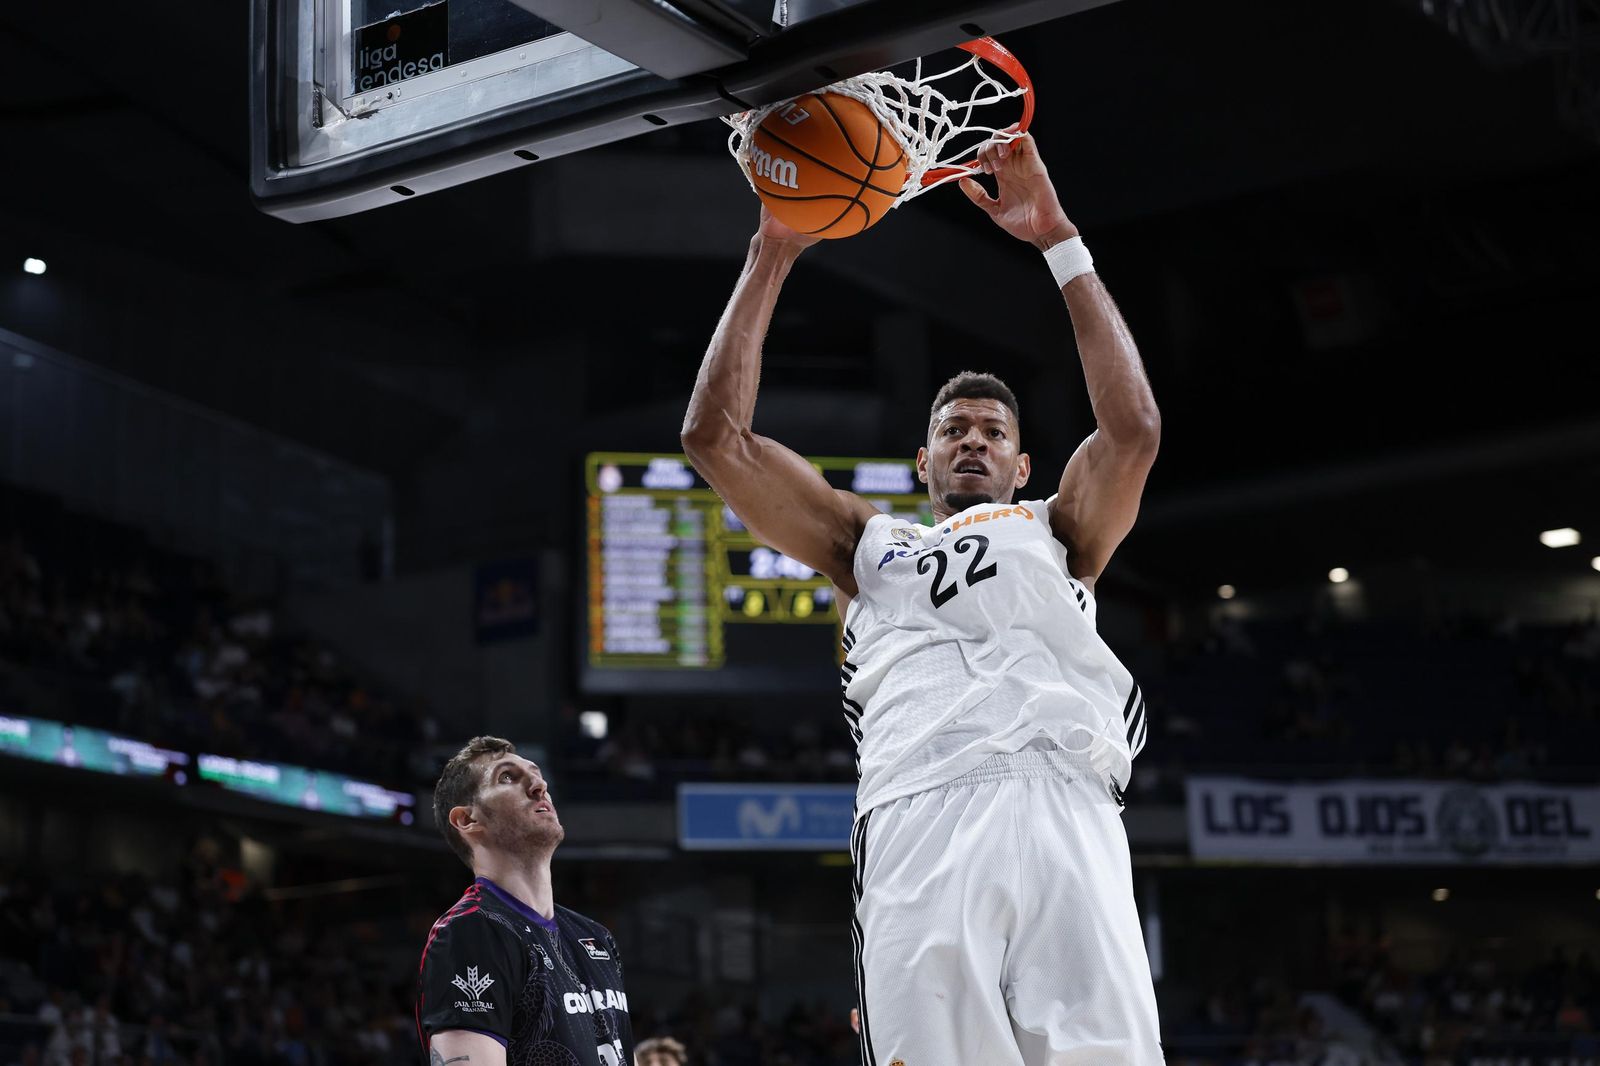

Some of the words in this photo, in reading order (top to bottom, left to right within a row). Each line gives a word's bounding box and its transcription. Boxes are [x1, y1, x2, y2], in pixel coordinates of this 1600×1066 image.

[360, 43, 397, 70] liga
[360, 52, 444, 91] endesa
[775, 101, 810, 126] EV
[916, 534, 998, 610] 22
[1203, 793, 1292, 837] LOS
[1318, 794, 1426, 838] OJOS
[1505, 795, 1591, 839] DEL
[471, 1000, 495, 1010] RURAL
